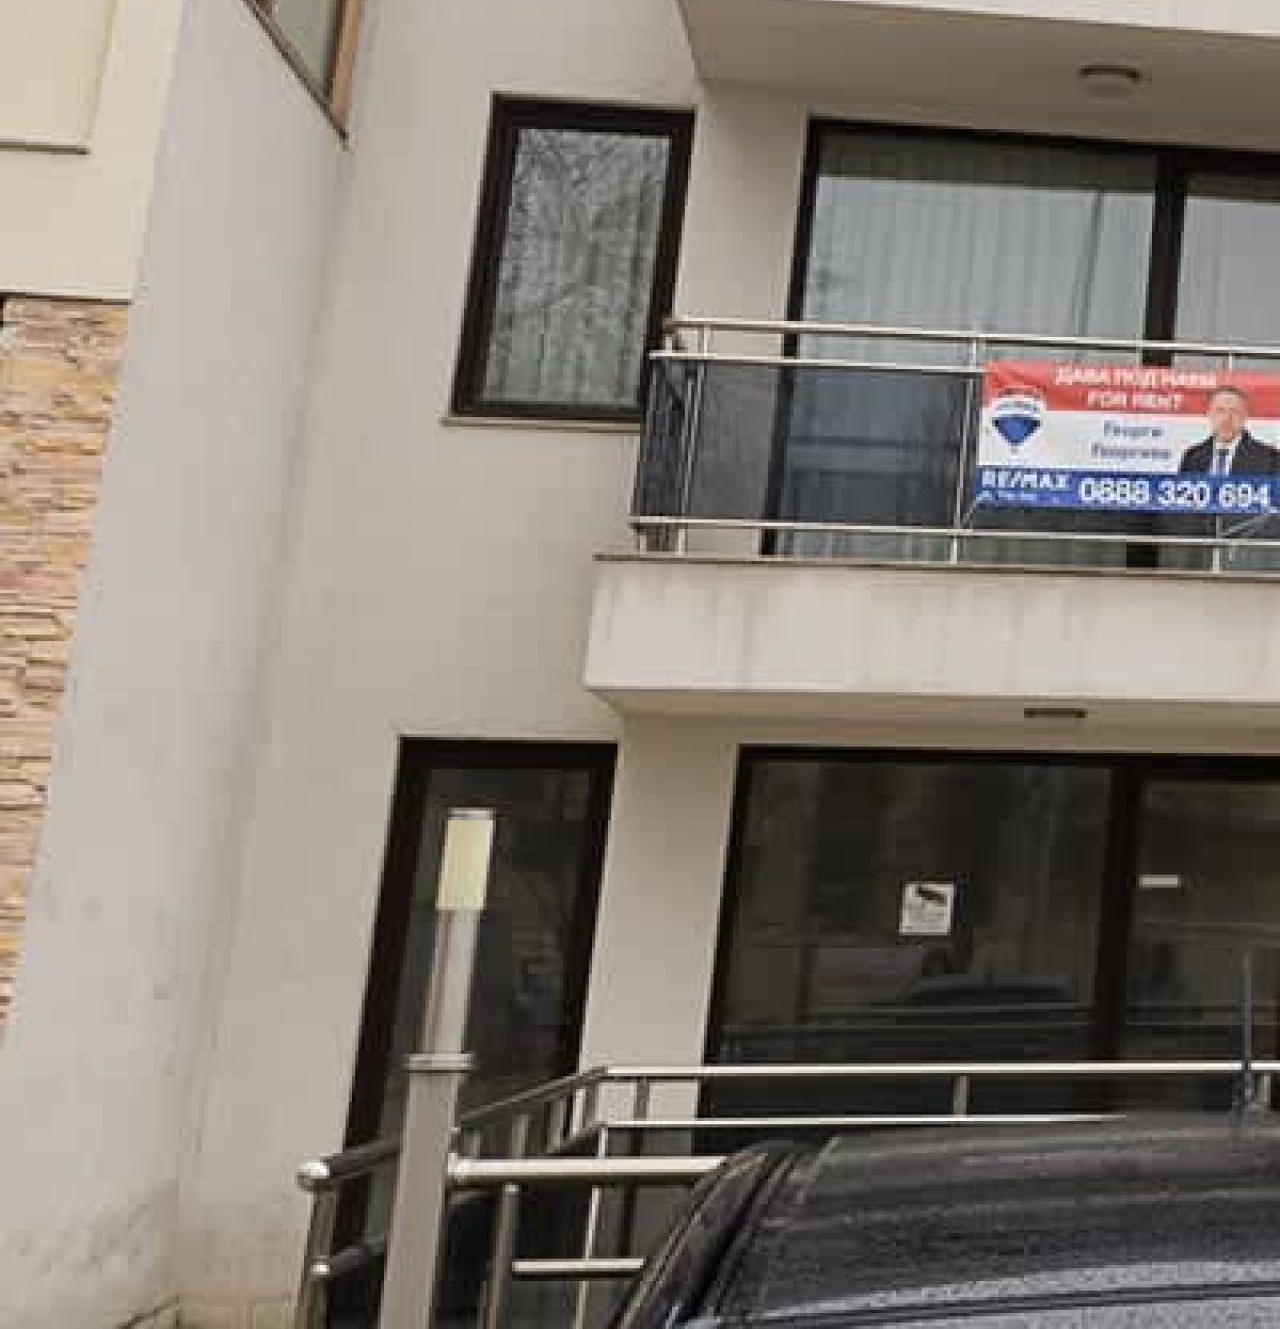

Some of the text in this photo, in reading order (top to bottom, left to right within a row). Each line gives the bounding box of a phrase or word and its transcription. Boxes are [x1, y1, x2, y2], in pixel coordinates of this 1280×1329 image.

[1087, 390, 1184, 409] FOR RENT
[981, 470, 1071, 489] RE/MAX
[1078, 479, 1271, 508] 0888 320 694
